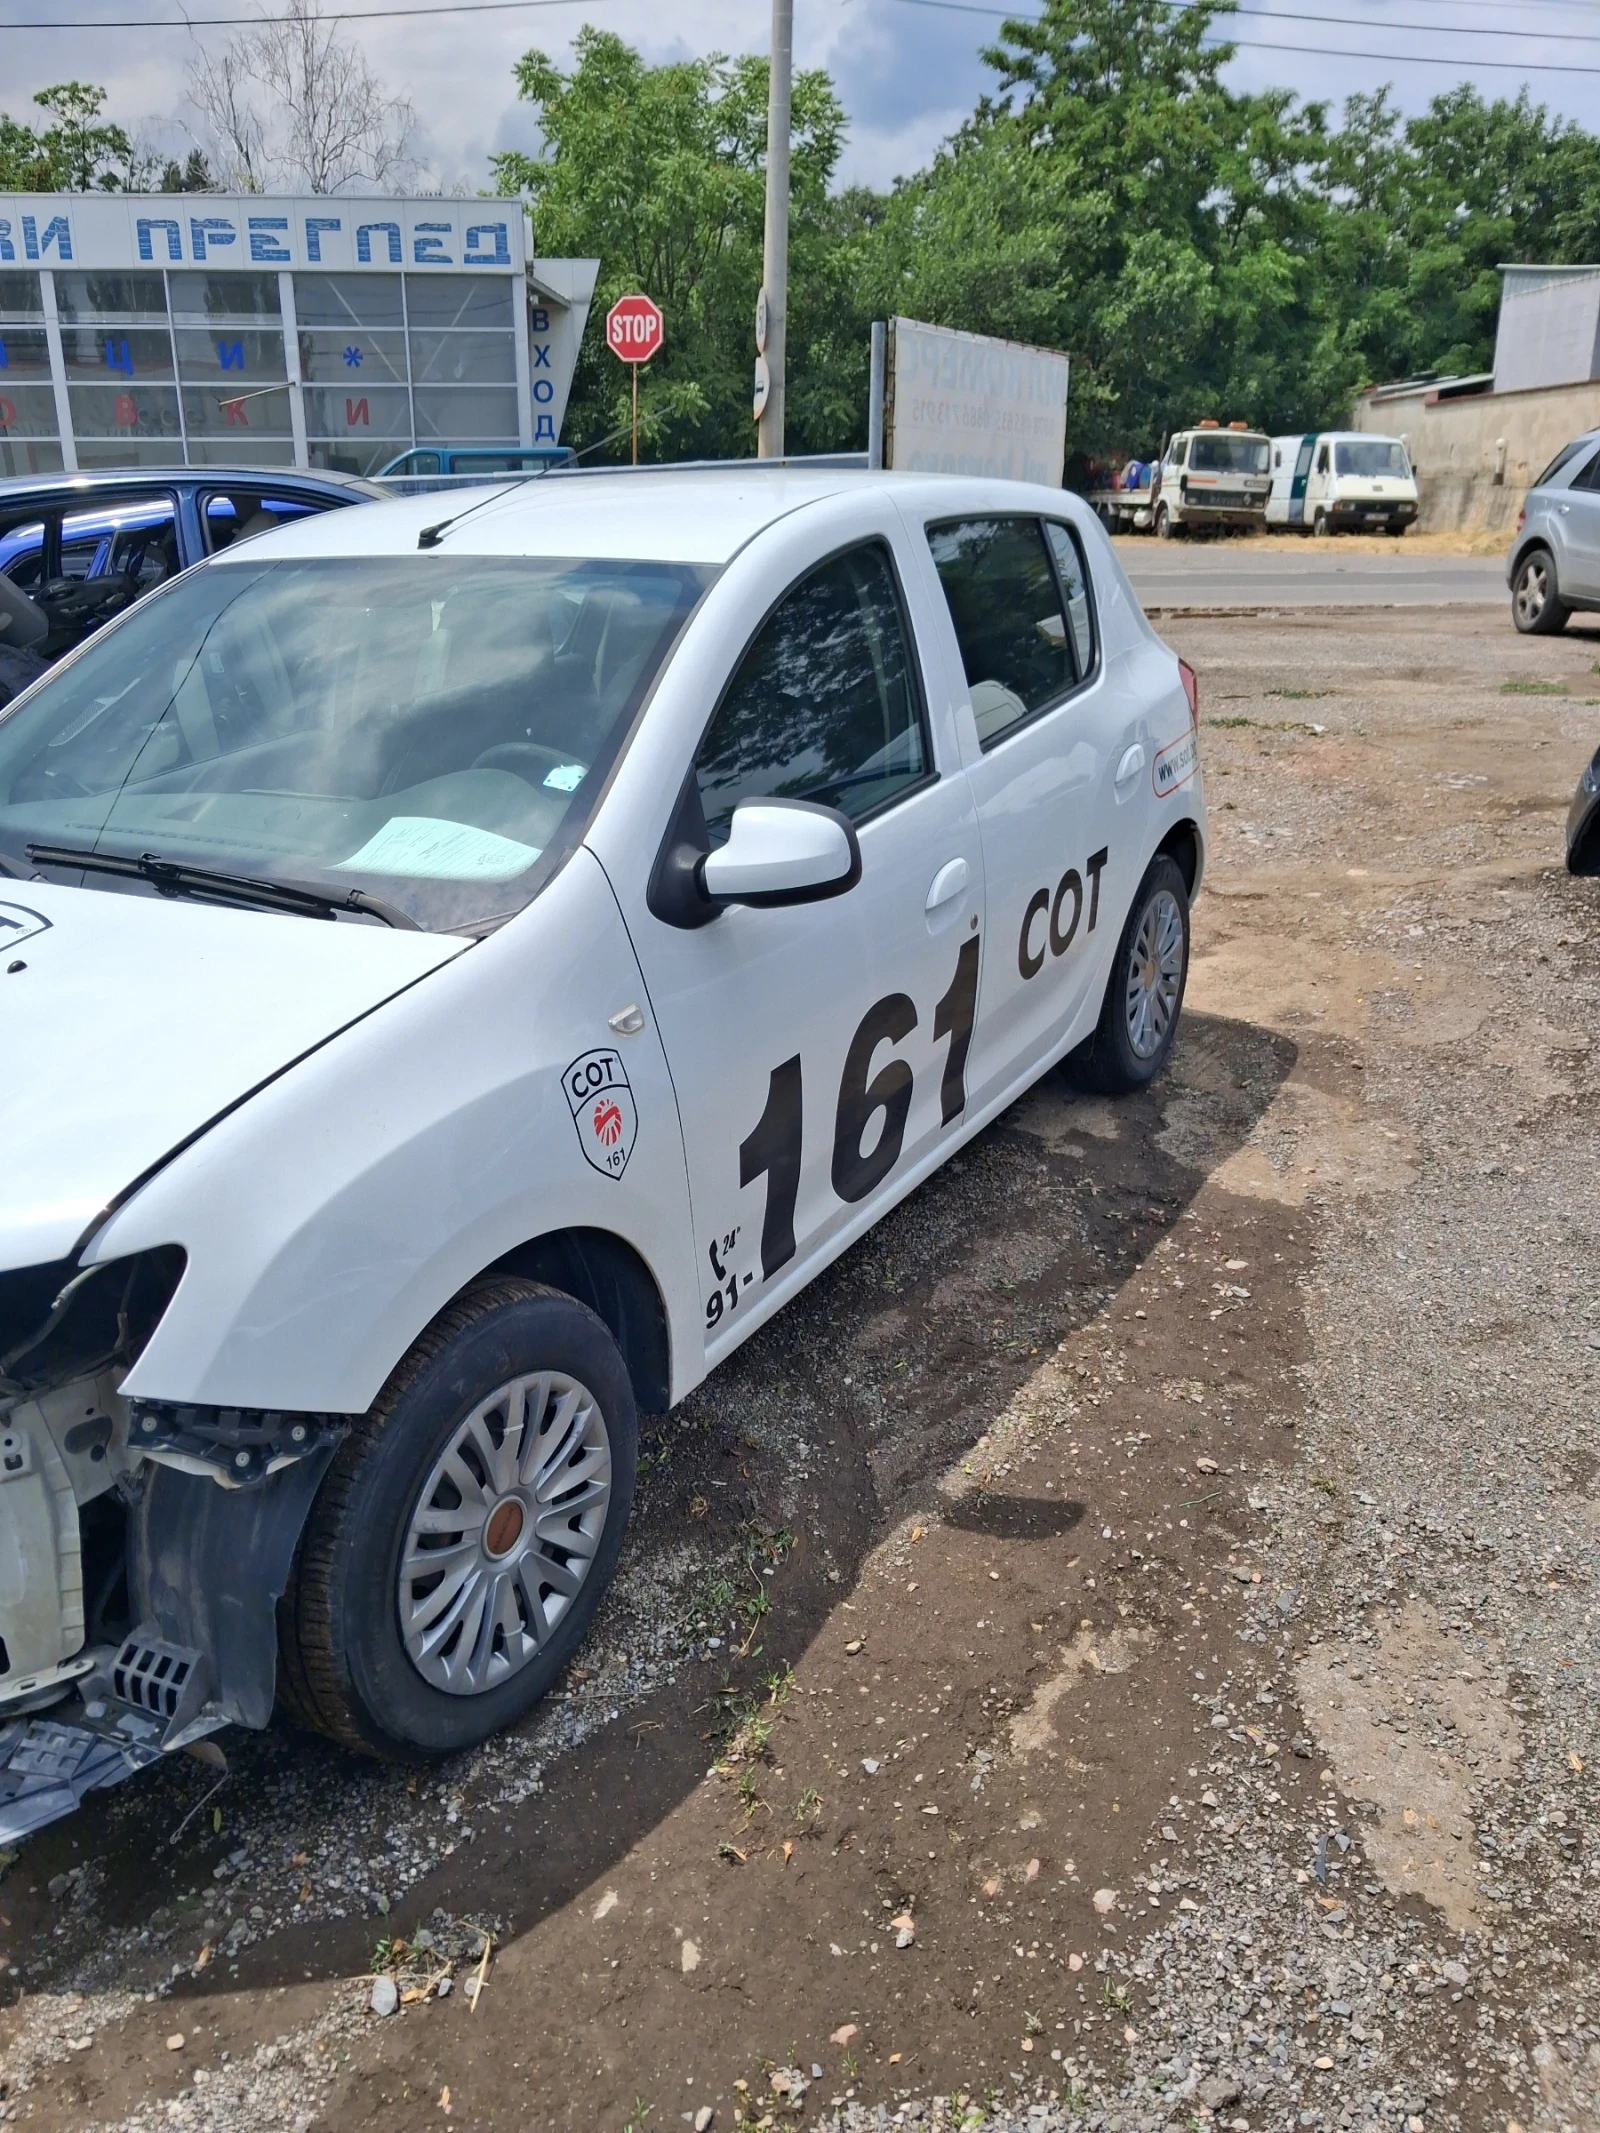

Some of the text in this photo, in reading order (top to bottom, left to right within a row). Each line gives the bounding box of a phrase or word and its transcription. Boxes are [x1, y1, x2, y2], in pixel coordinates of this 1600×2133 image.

[136, 216, 511, 264] ПРЕГЛЕД
[612, 314, 657, 343] STOP
[532, 308, 555, 442] ВХОД
[739, 933, 980, 1283] 161
[606, 1147, 626, 1170] 161
